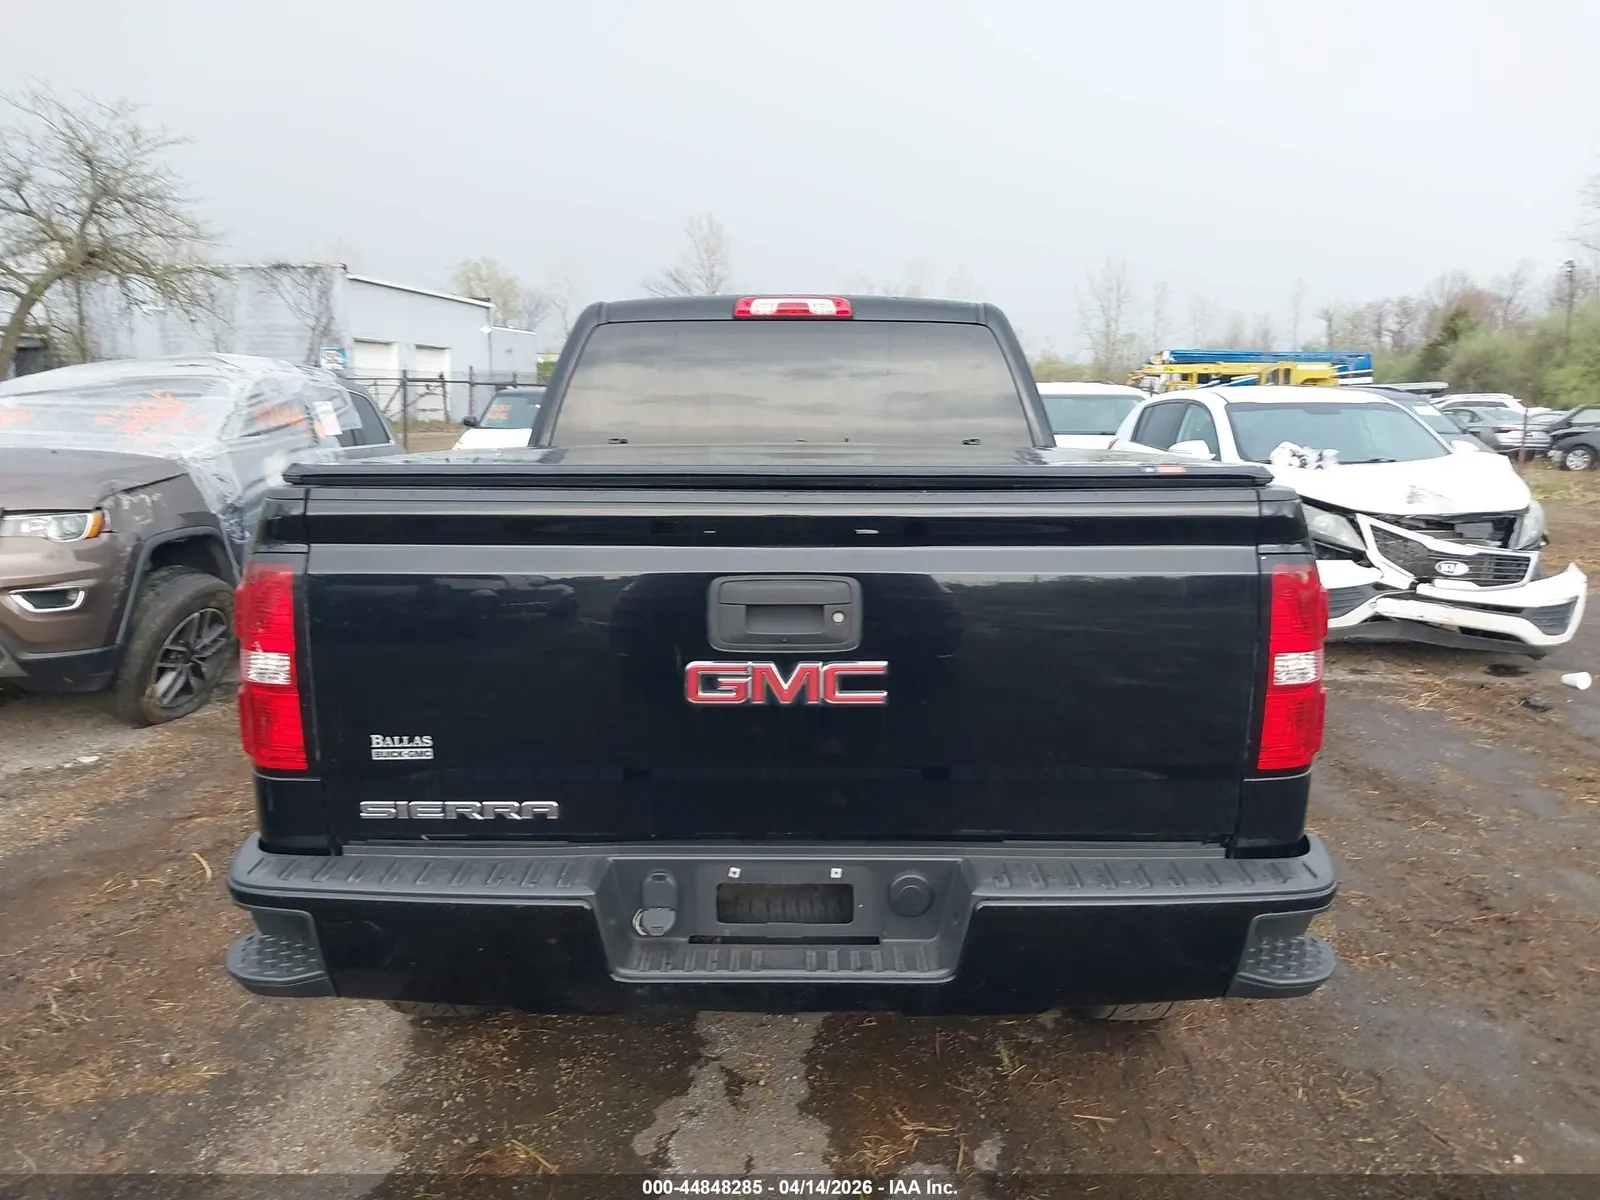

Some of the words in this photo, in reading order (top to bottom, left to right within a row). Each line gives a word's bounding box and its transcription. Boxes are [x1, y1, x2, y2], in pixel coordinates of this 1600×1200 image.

[685, 660, 889, 705] GMC
[369, 734, 434, 747] BALLAS
[359, 800, 560, 820] SIERRA
